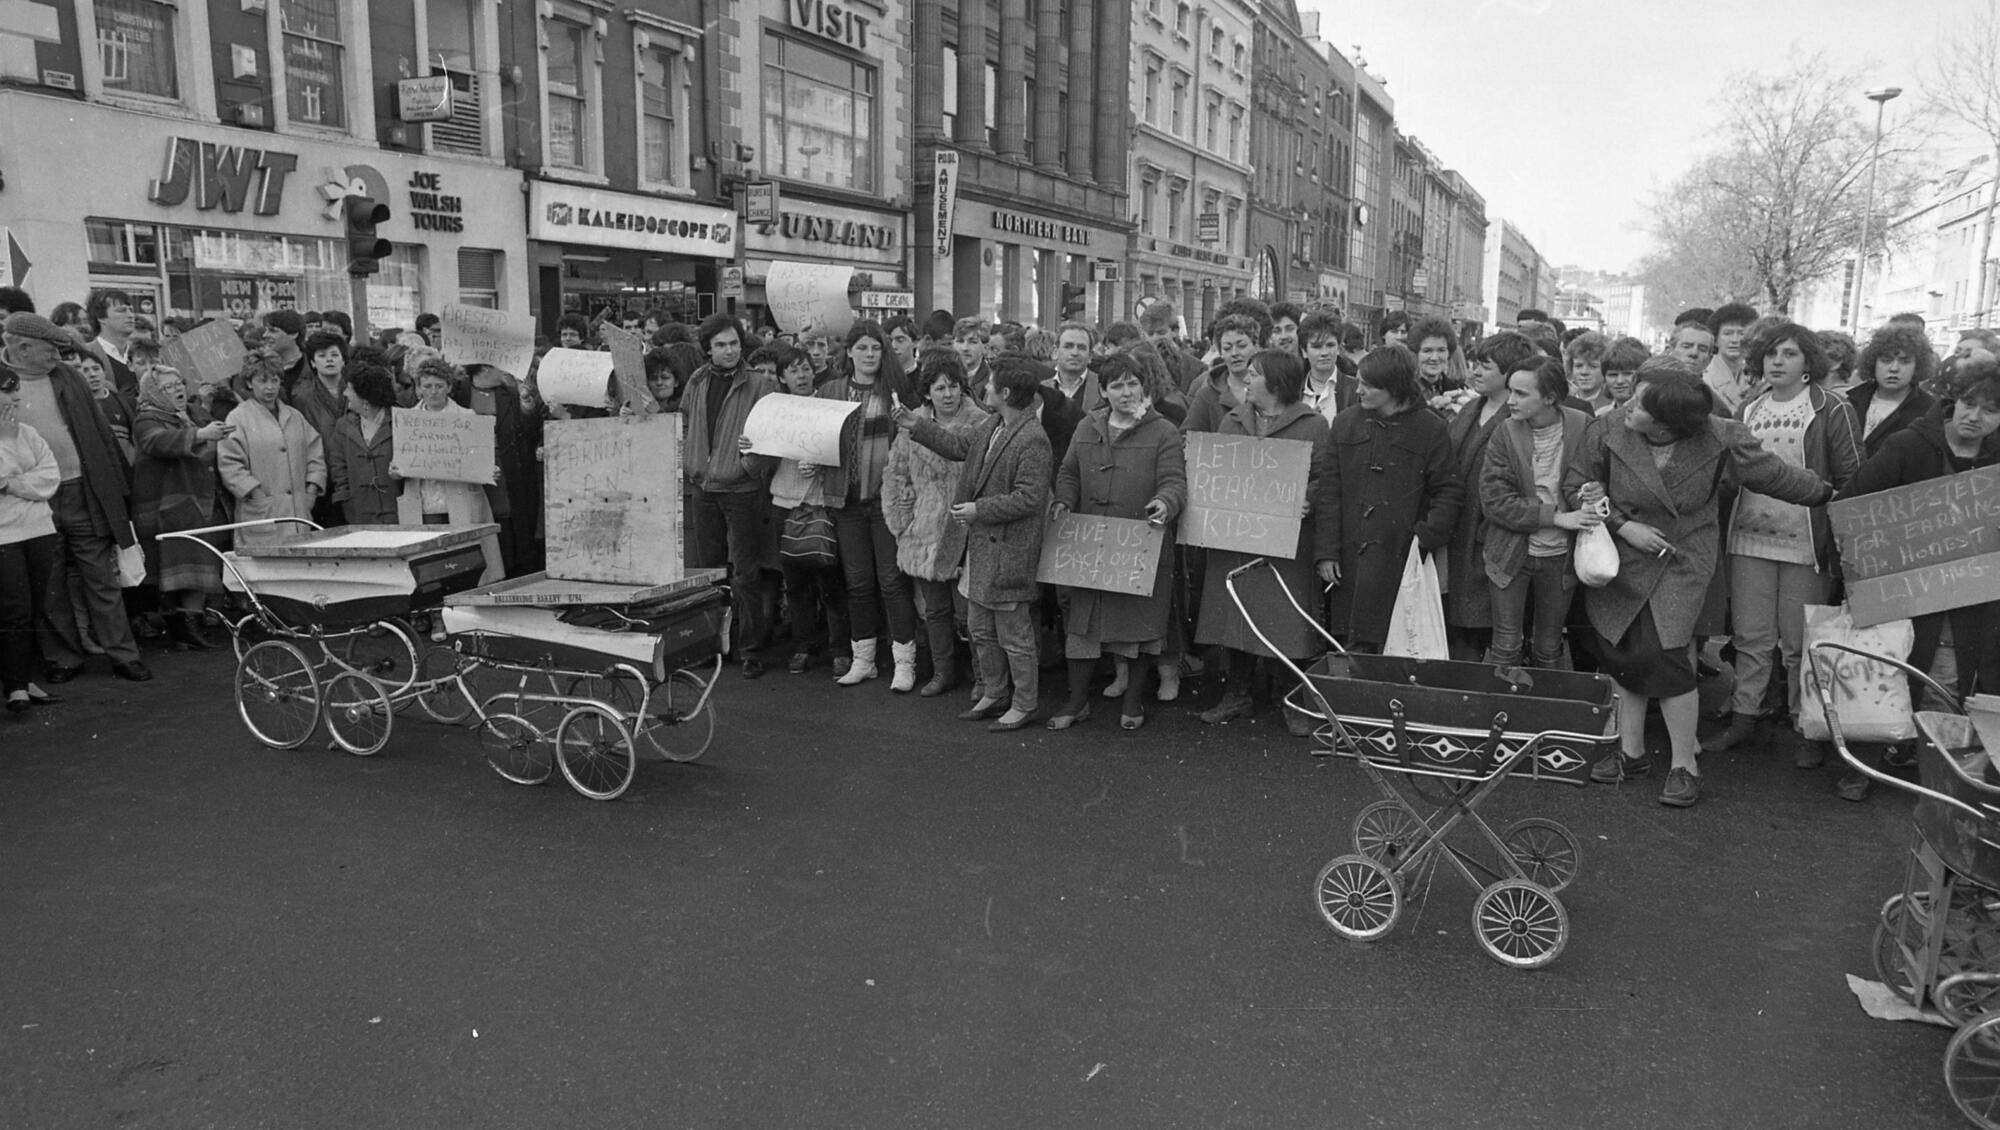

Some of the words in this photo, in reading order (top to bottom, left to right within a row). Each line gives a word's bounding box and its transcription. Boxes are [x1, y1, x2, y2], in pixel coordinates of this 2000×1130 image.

[797, 0, 870, 48] VISIT
[148, 136, 298, 215] JWT
[408, 170, 441, 190] JOE
[410, 191, 462, 213] WALSH
[937, 168, 948, 254] AMUSEMENTS
[410, 211, 464, 233] TOURS
[578, 207, 709, 239] KALEIDOSCOPE
[758, 211, 897, 250] UNLAND
[993, 211, 1058, 240] NORTHERN
[1062, 225, 1094, 246] BANK
[220, 280, 252, 295] NEW
[255, 280, 296, 297] YORK
[222, 298, 252, 313] LOS
[1196, 436, 1241, 469] LET
[1250, 446, 1279, 469] US
[1192, 470, 1257, 503] REAR
[1848, 474, 1995, 531] ARRESTED
[1058, 520, 1107, 543] GIVE
[1117, 525, 1143, 547] US
[1202, 510, 1272, 540] KIDS
[1055, 544, 1107, 572] BACK
[1110, 551, 1146, 571] OUR
[1854, 529, 1891, 560] FOR
